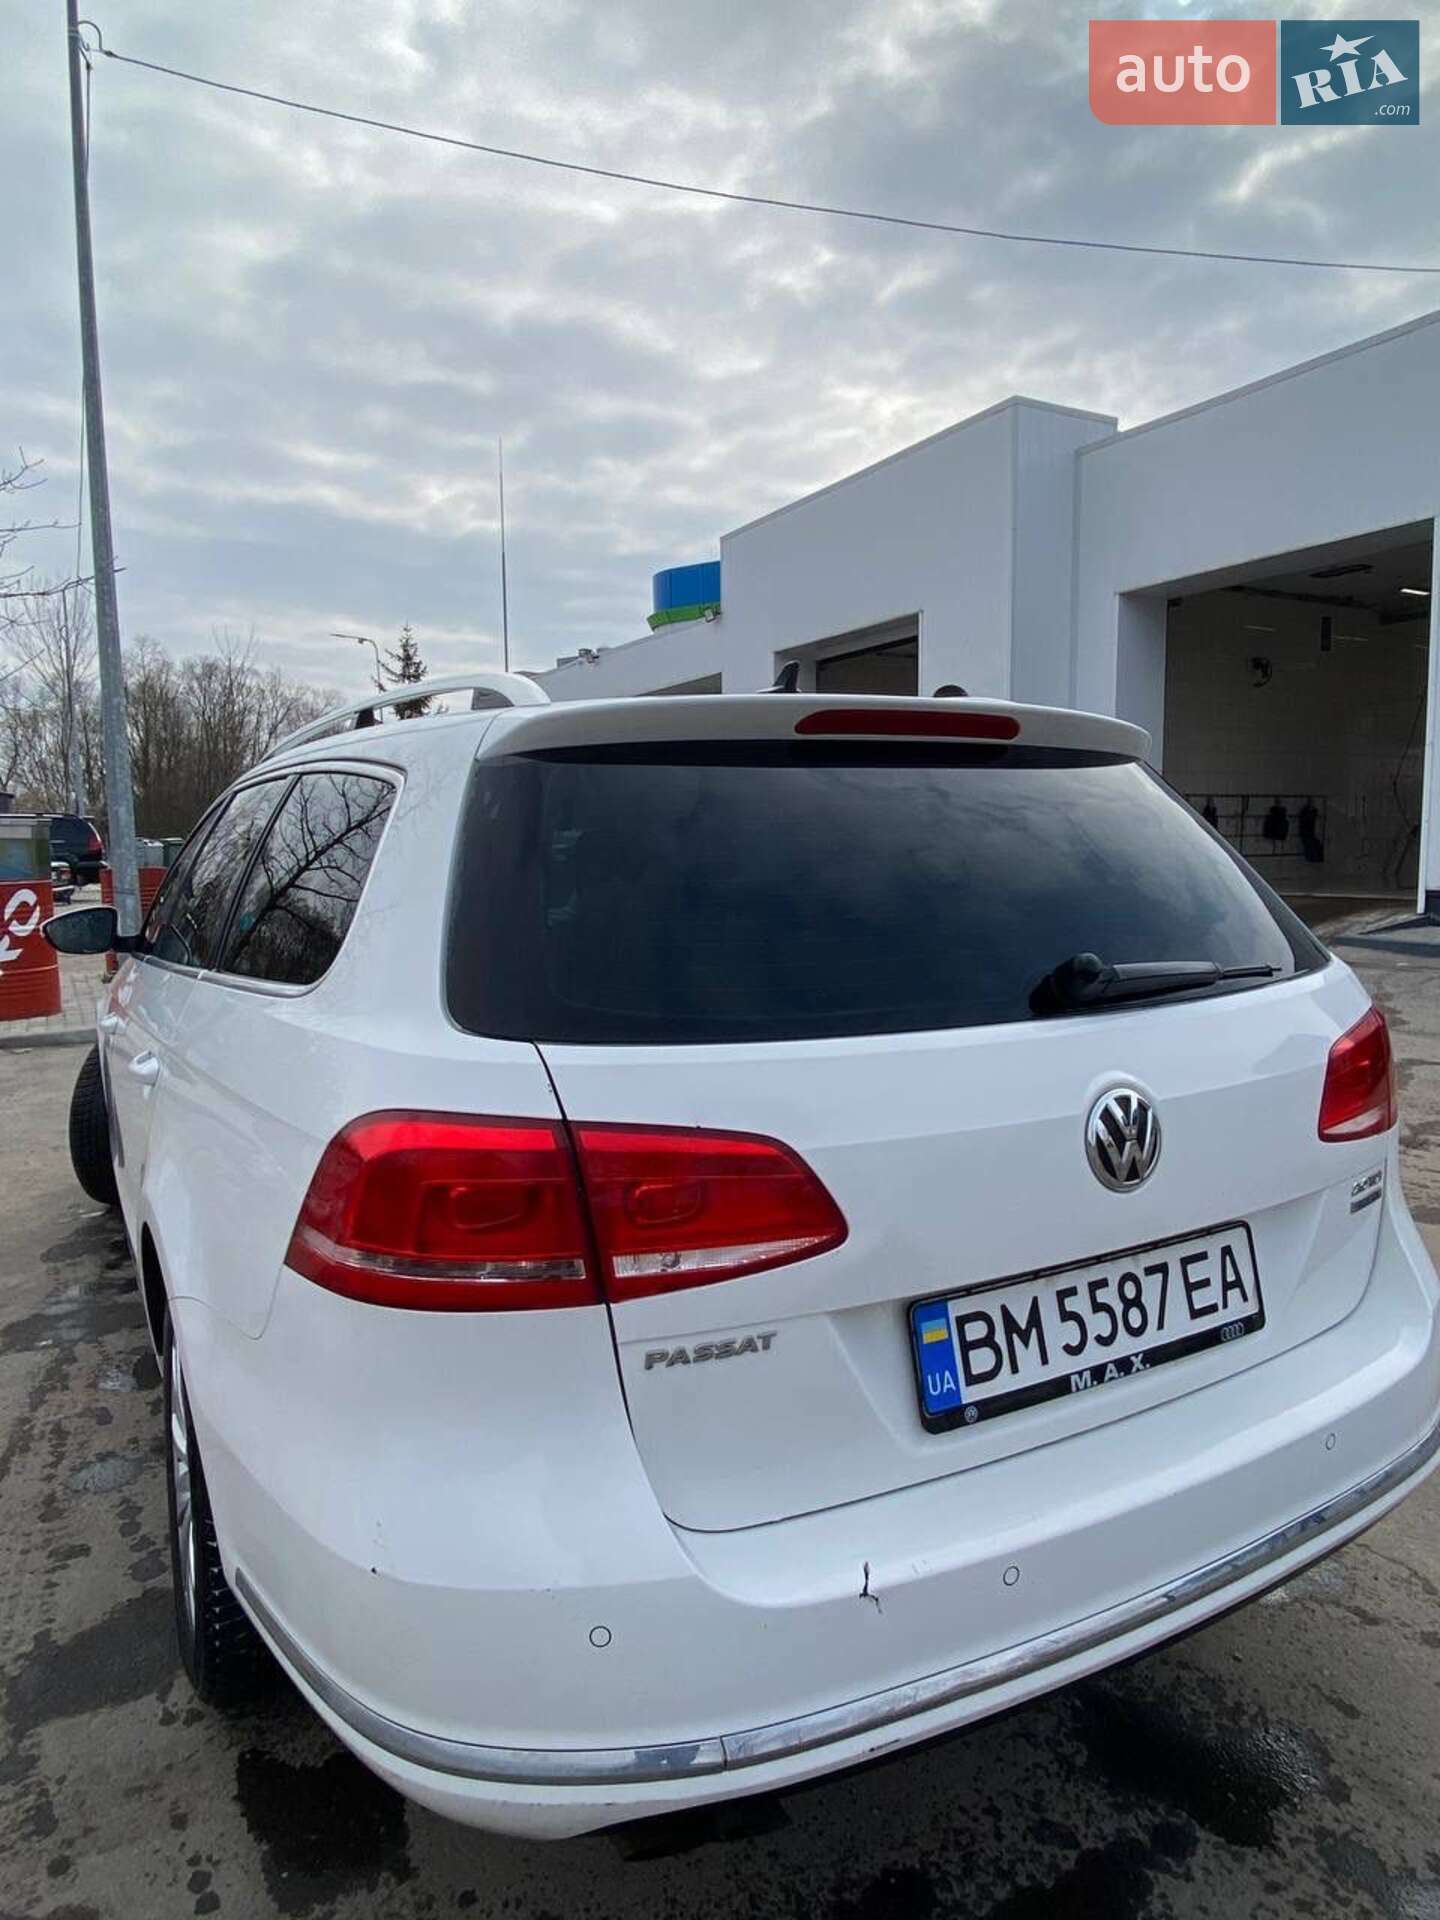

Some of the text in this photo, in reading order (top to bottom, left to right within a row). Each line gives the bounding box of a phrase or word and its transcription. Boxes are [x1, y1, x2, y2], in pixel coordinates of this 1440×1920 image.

[954, 1244, 1249, 1387] BM 5587 EA
[644, 1330, 778, 1370] PASSAT
[927, 1369, 956, 1396] UA
